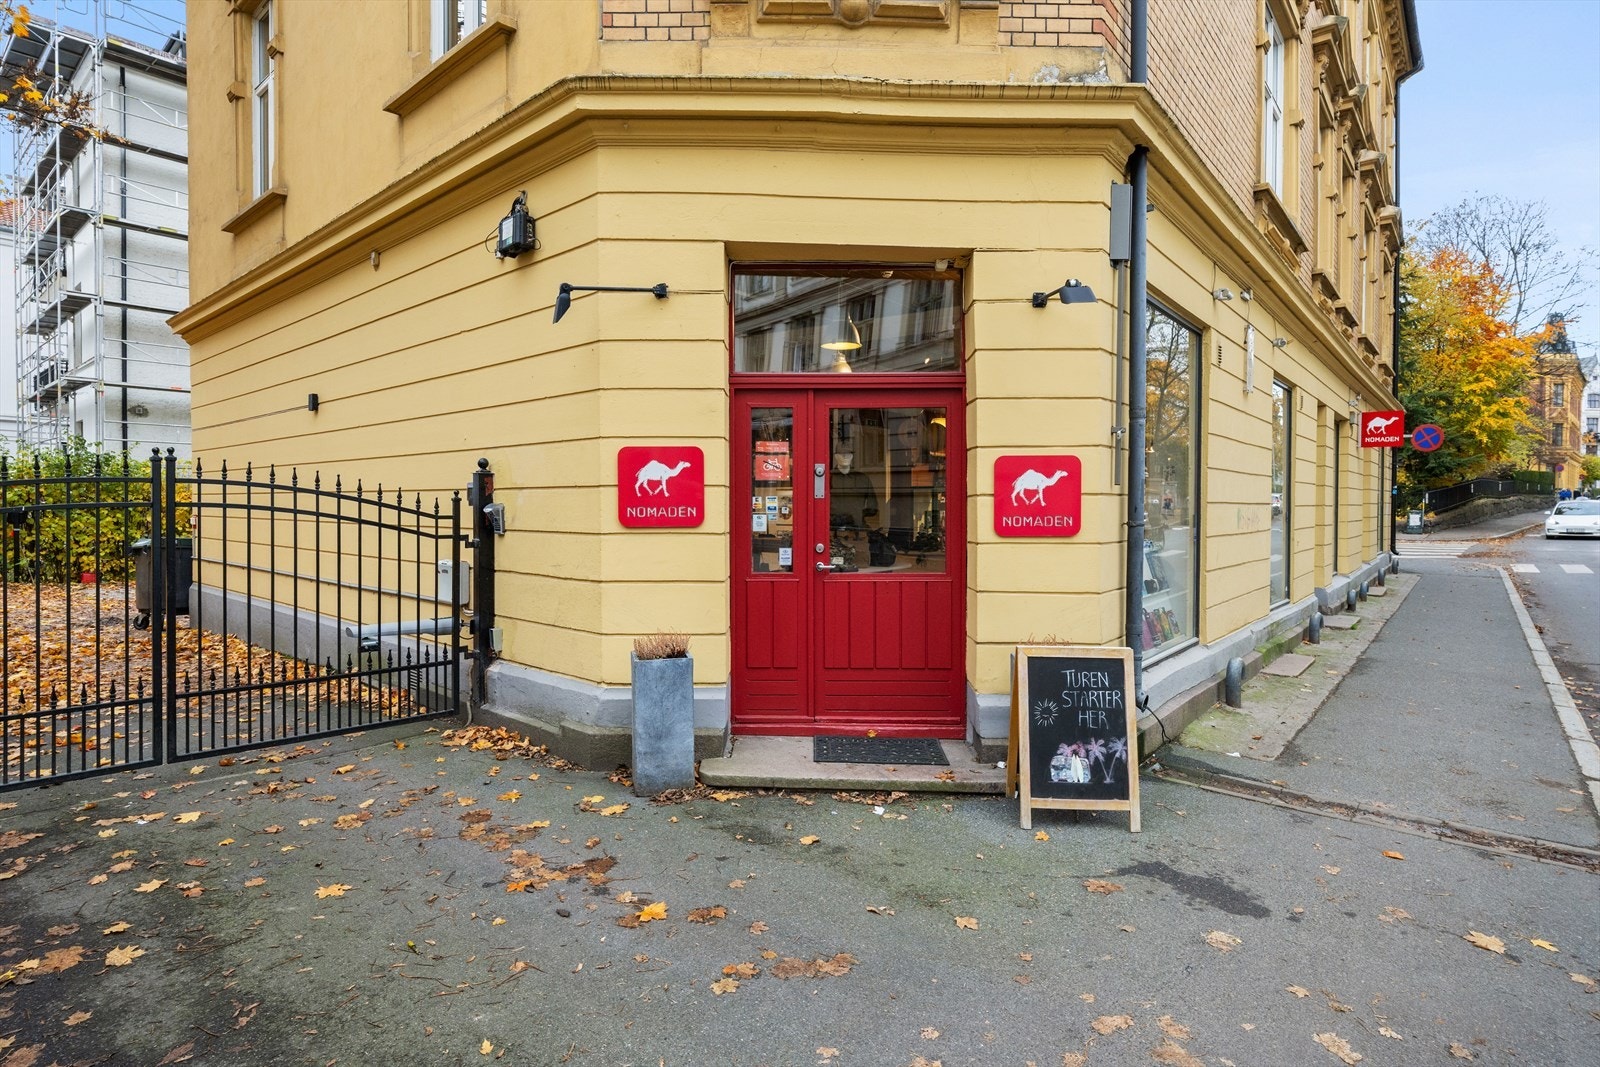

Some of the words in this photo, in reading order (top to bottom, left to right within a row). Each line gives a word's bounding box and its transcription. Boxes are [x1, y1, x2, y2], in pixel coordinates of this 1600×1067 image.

[627, 506, 697, 518] NOMADEN
[1002, 515, 1073, 527] NOMADEN
[1061, 669, 1110, 688] TUREN
[1061, 690, 1123, 709] STARTER
[1078, 710, 1109, 730] HER
